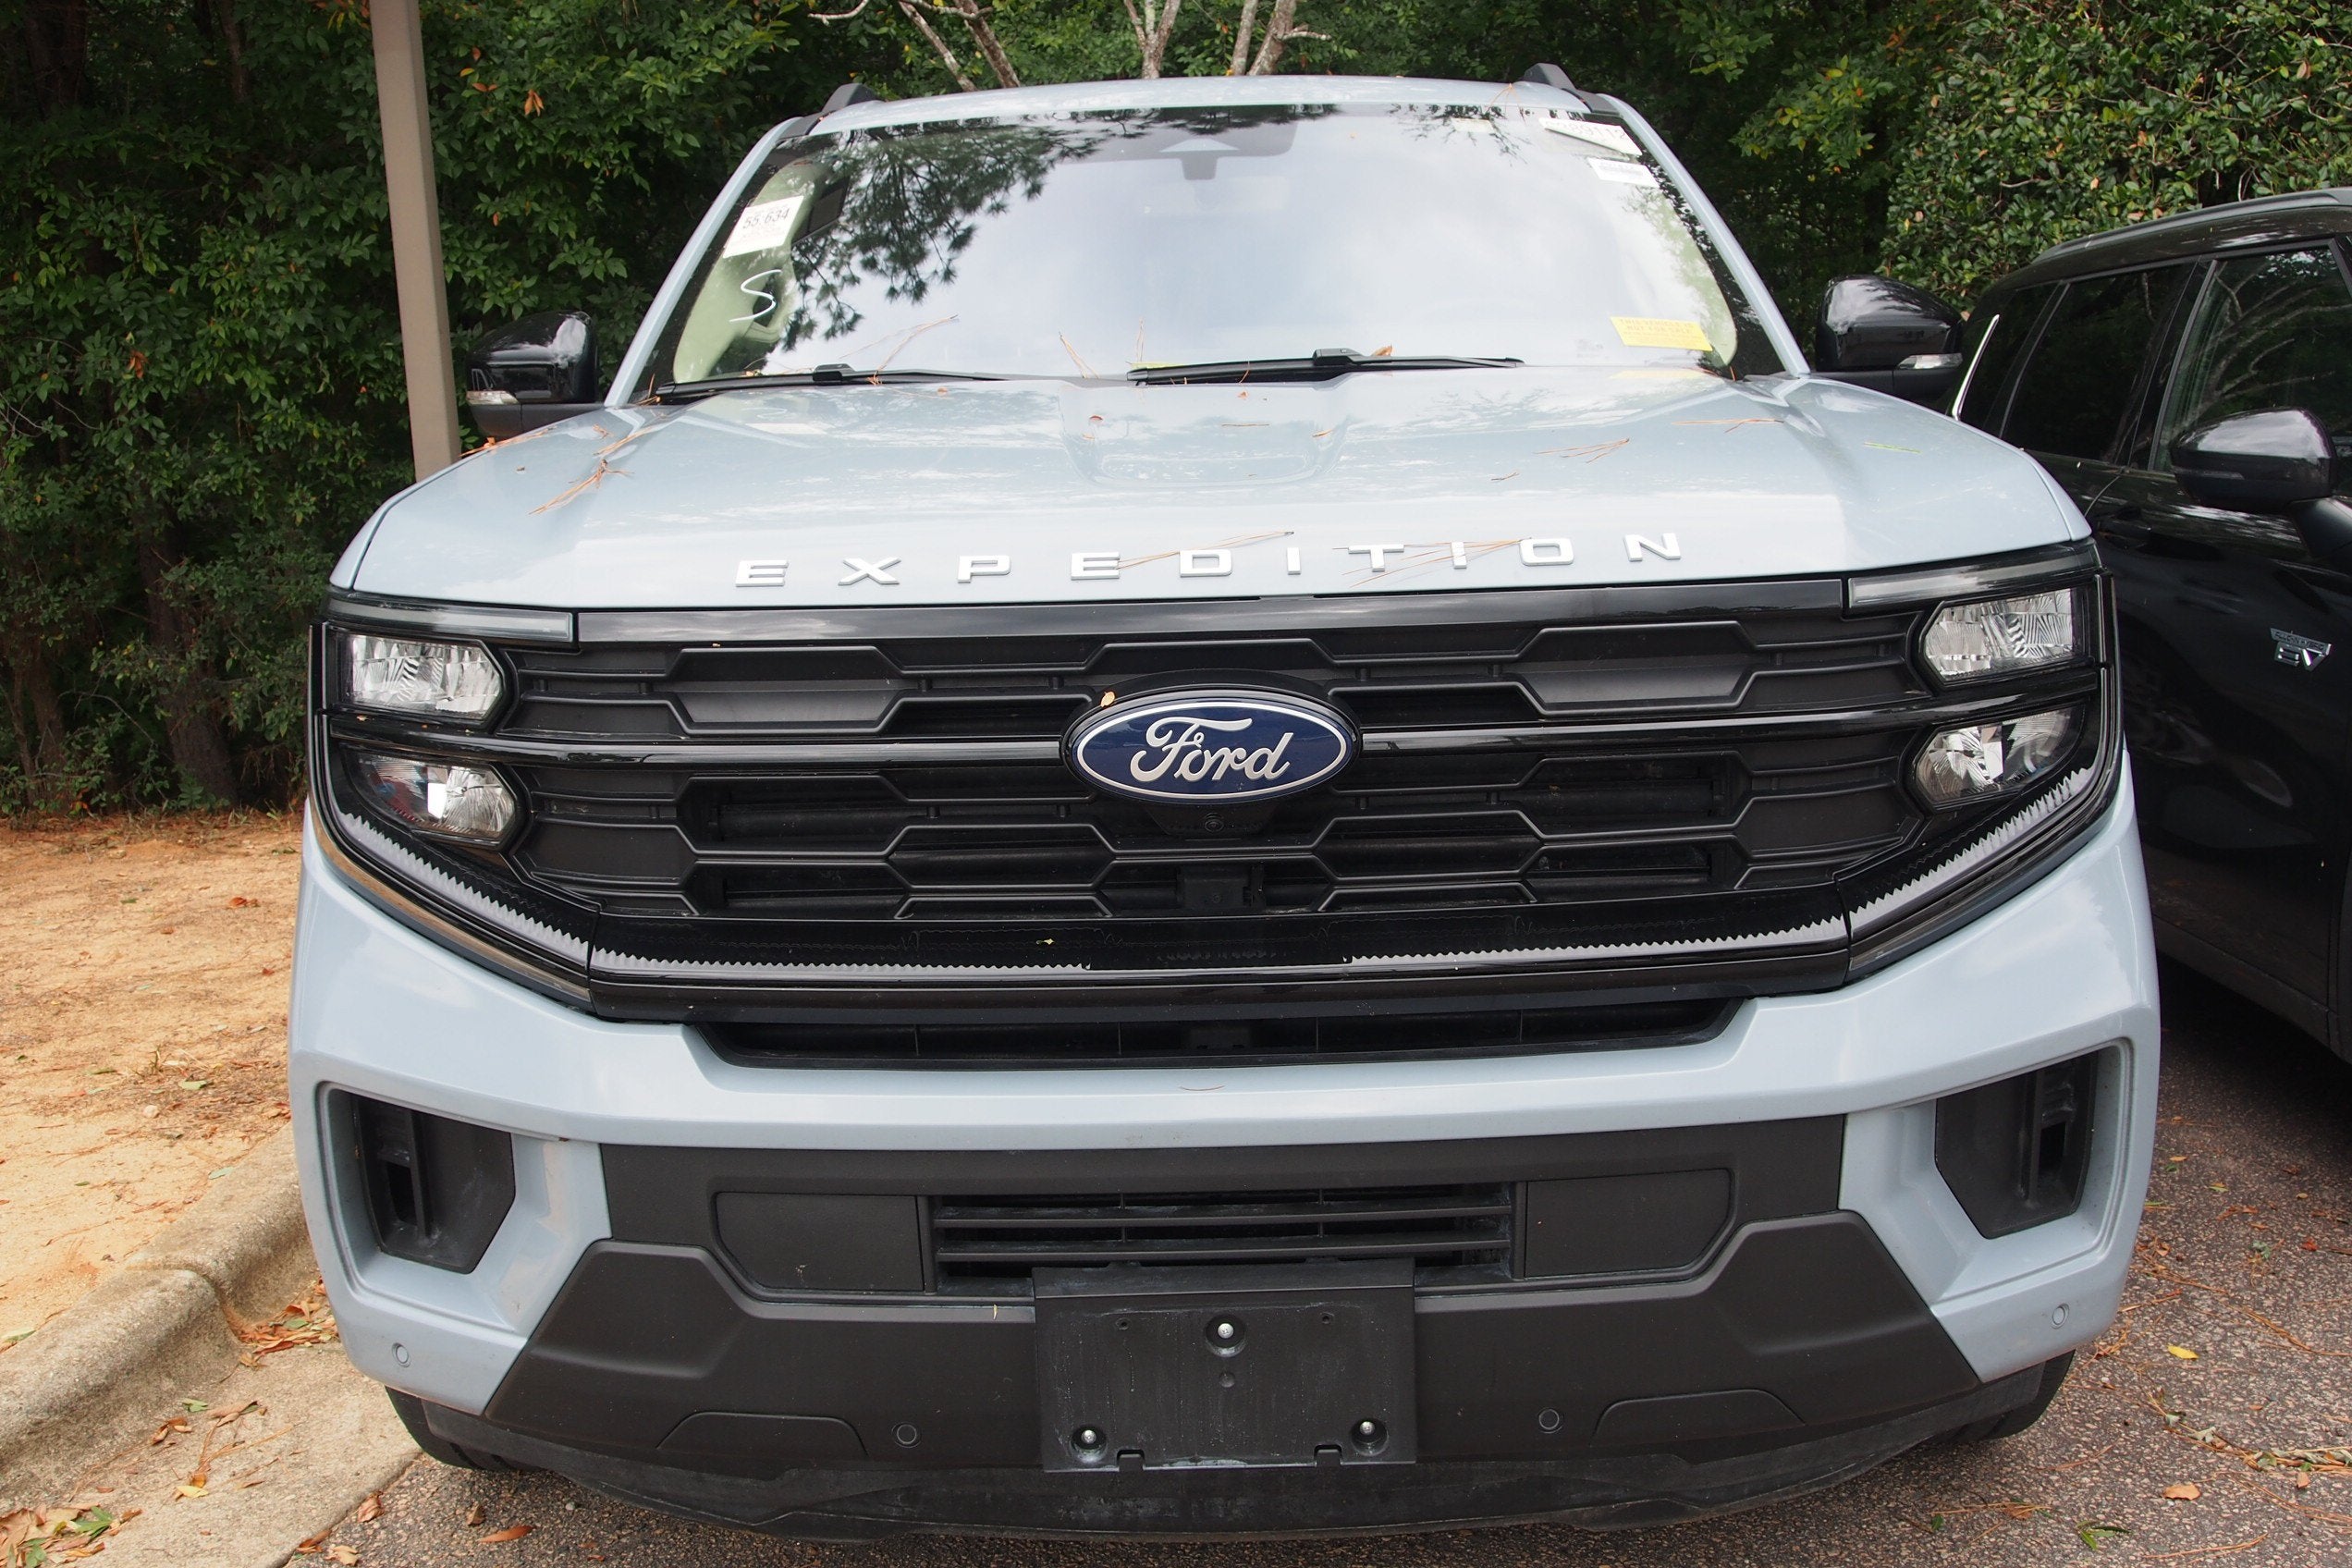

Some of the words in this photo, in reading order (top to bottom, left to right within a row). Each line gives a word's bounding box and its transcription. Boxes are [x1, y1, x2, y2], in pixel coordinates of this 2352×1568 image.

[735, 533, 1682, 587] EXPEDITION
[2274, 642, 2331, 672] EV
[1130, 717, 1293, 781] Ford
